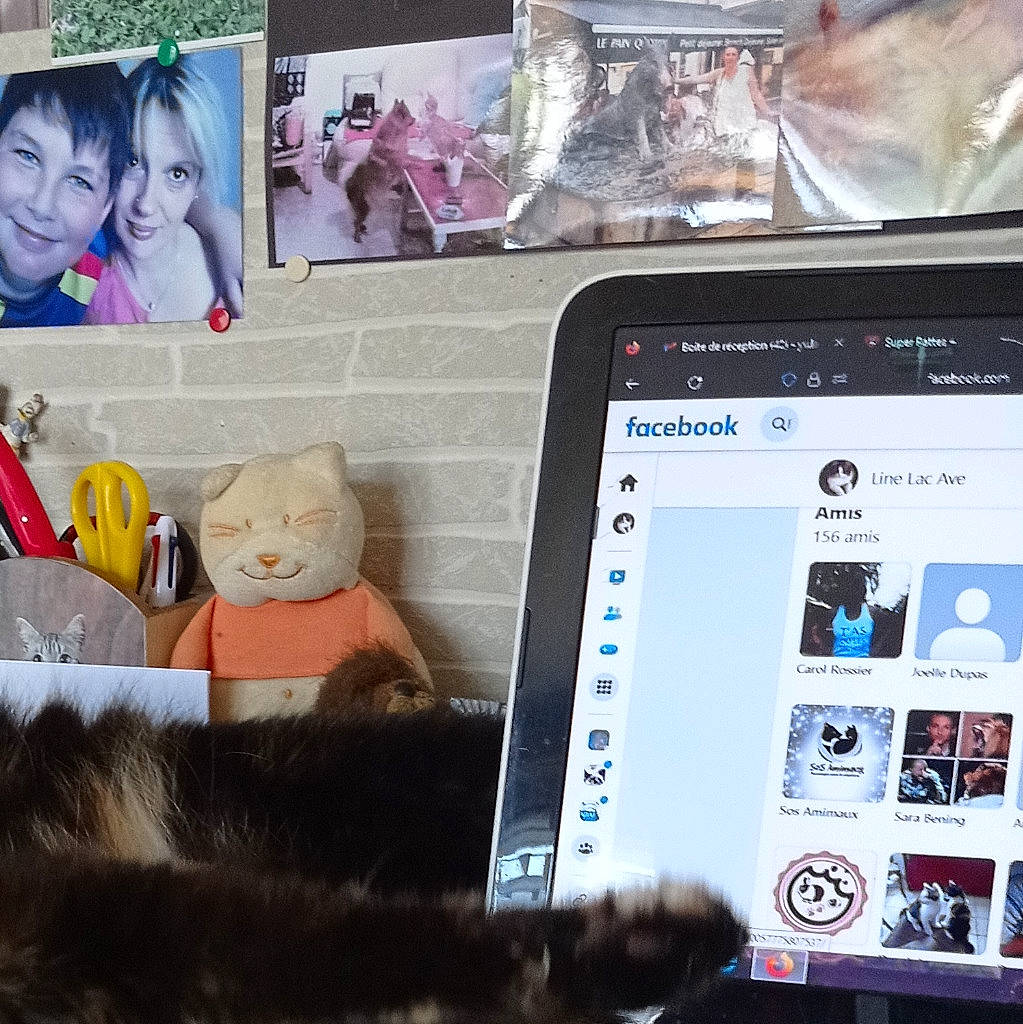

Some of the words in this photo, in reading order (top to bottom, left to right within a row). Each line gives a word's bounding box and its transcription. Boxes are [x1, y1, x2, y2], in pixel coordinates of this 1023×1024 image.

[626, 415, 738, 437] facebook
[872, 472, 903, 485] Line
[908, 472, 932, 485] Lac
[936, 472, 966, 485] Ave
[815, 507, 862, 520] Amis
[814, 530, 840, 543] 156
[844, 530, 880, 544] amis
[894, 811, 920, 822] Sara
